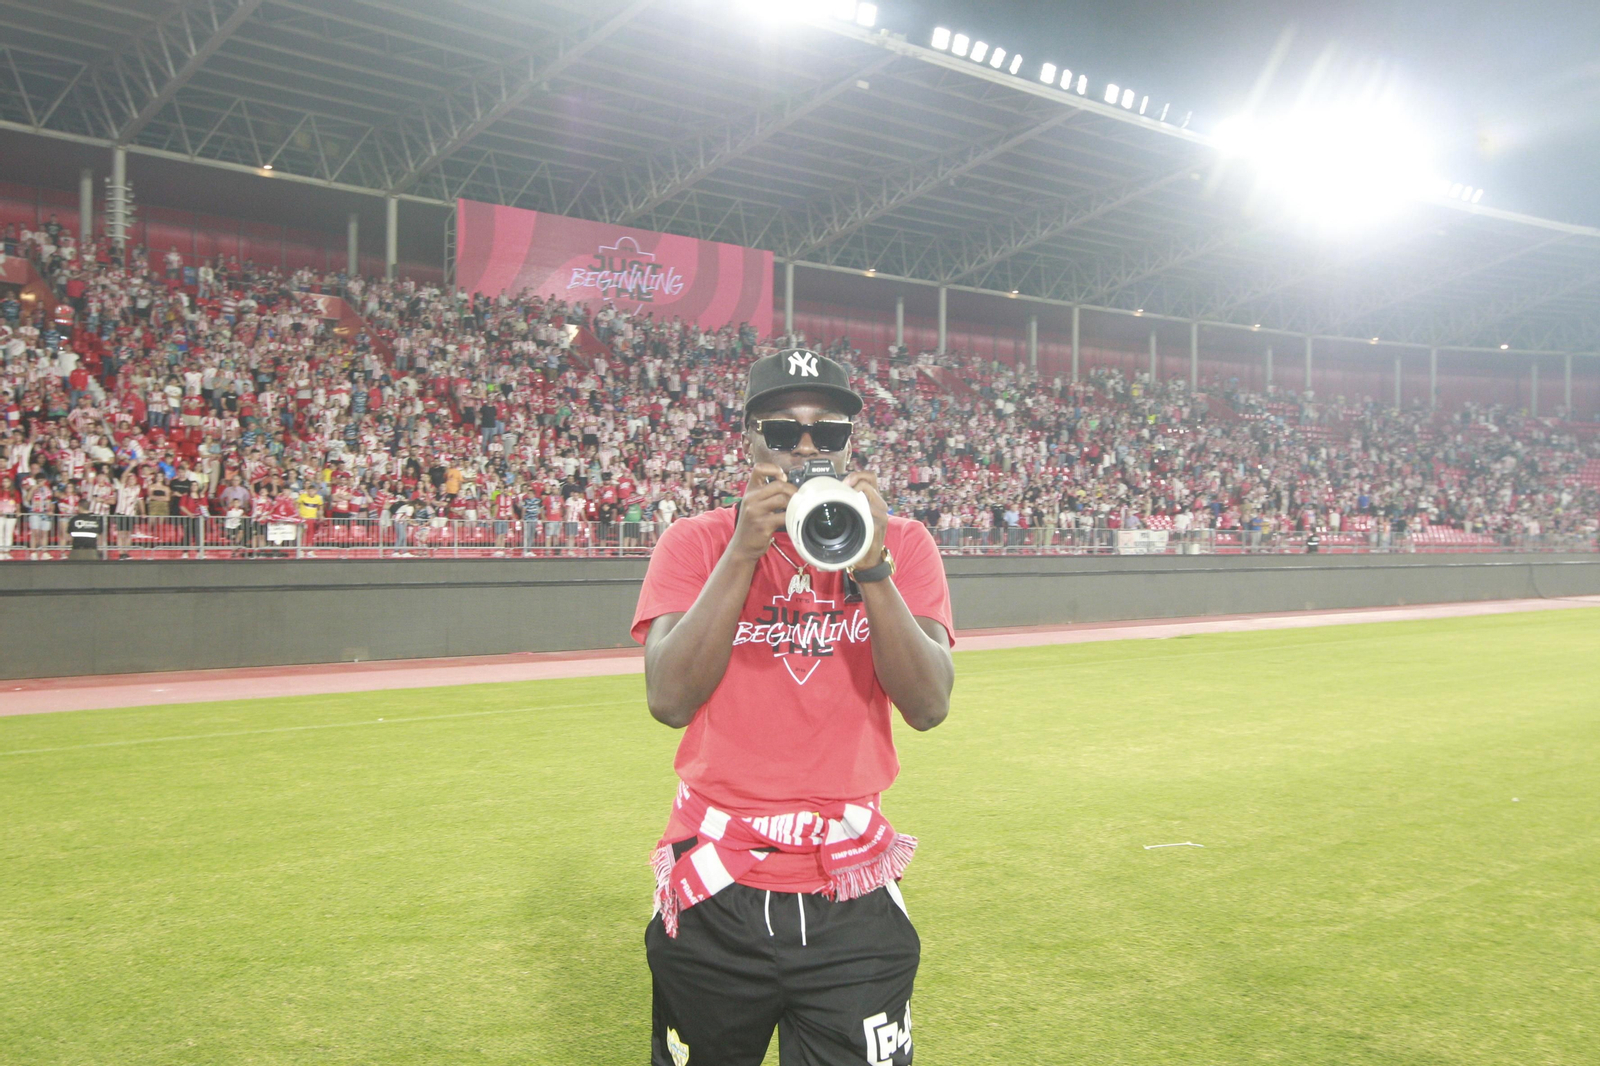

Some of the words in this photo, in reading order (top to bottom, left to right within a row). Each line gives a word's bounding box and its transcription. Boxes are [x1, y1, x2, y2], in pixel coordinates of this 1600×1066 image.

[566, 264, 684, 295] BEGINNING
[588, 254, 663, 280] JUST
[788, 351, 819, 377] NY
[732, 609, 870, 647] BEGINNING
[755, 606, 844, 631] JUST
